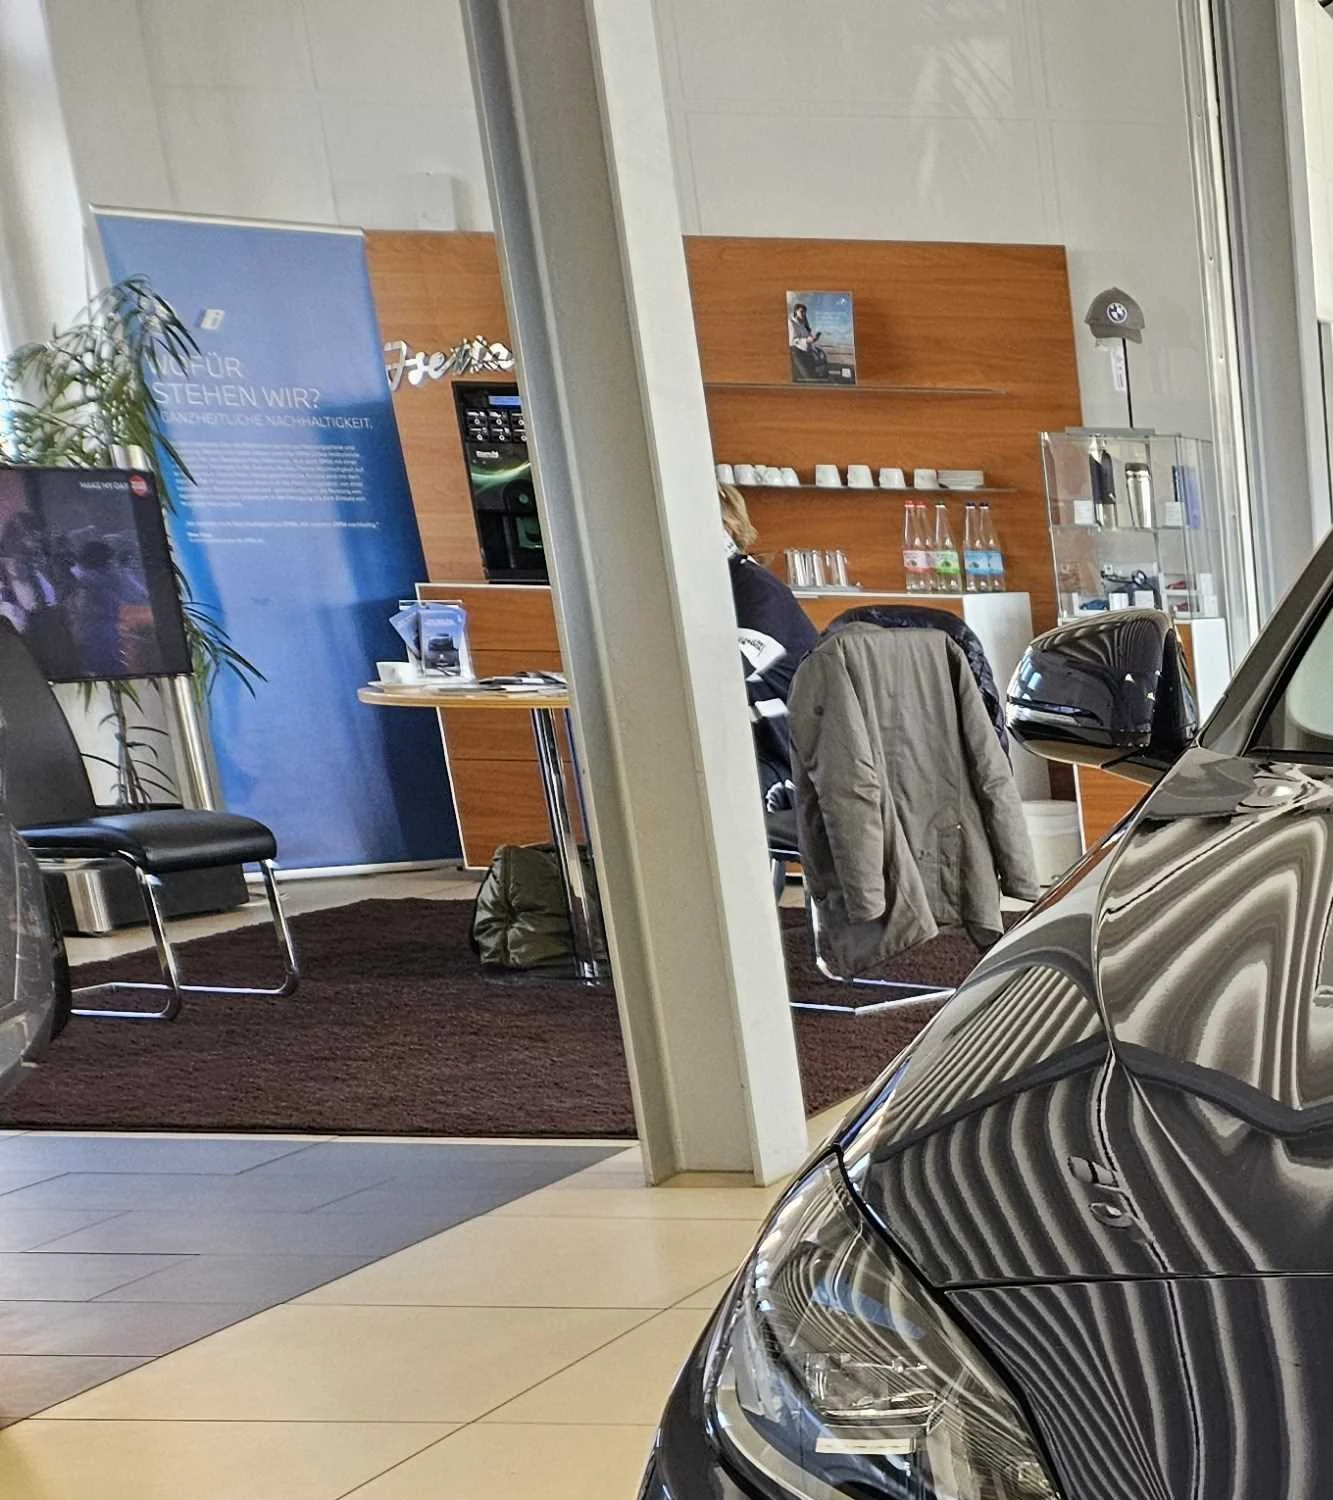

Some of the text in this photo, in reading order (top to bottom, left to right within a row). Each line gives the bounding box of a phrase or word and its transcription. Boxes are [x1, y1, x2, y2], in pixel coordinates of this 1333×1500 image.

[143, 351, 247, 379] WOFÜR
[151, 381, 321, 410] STEHEN WIR?
